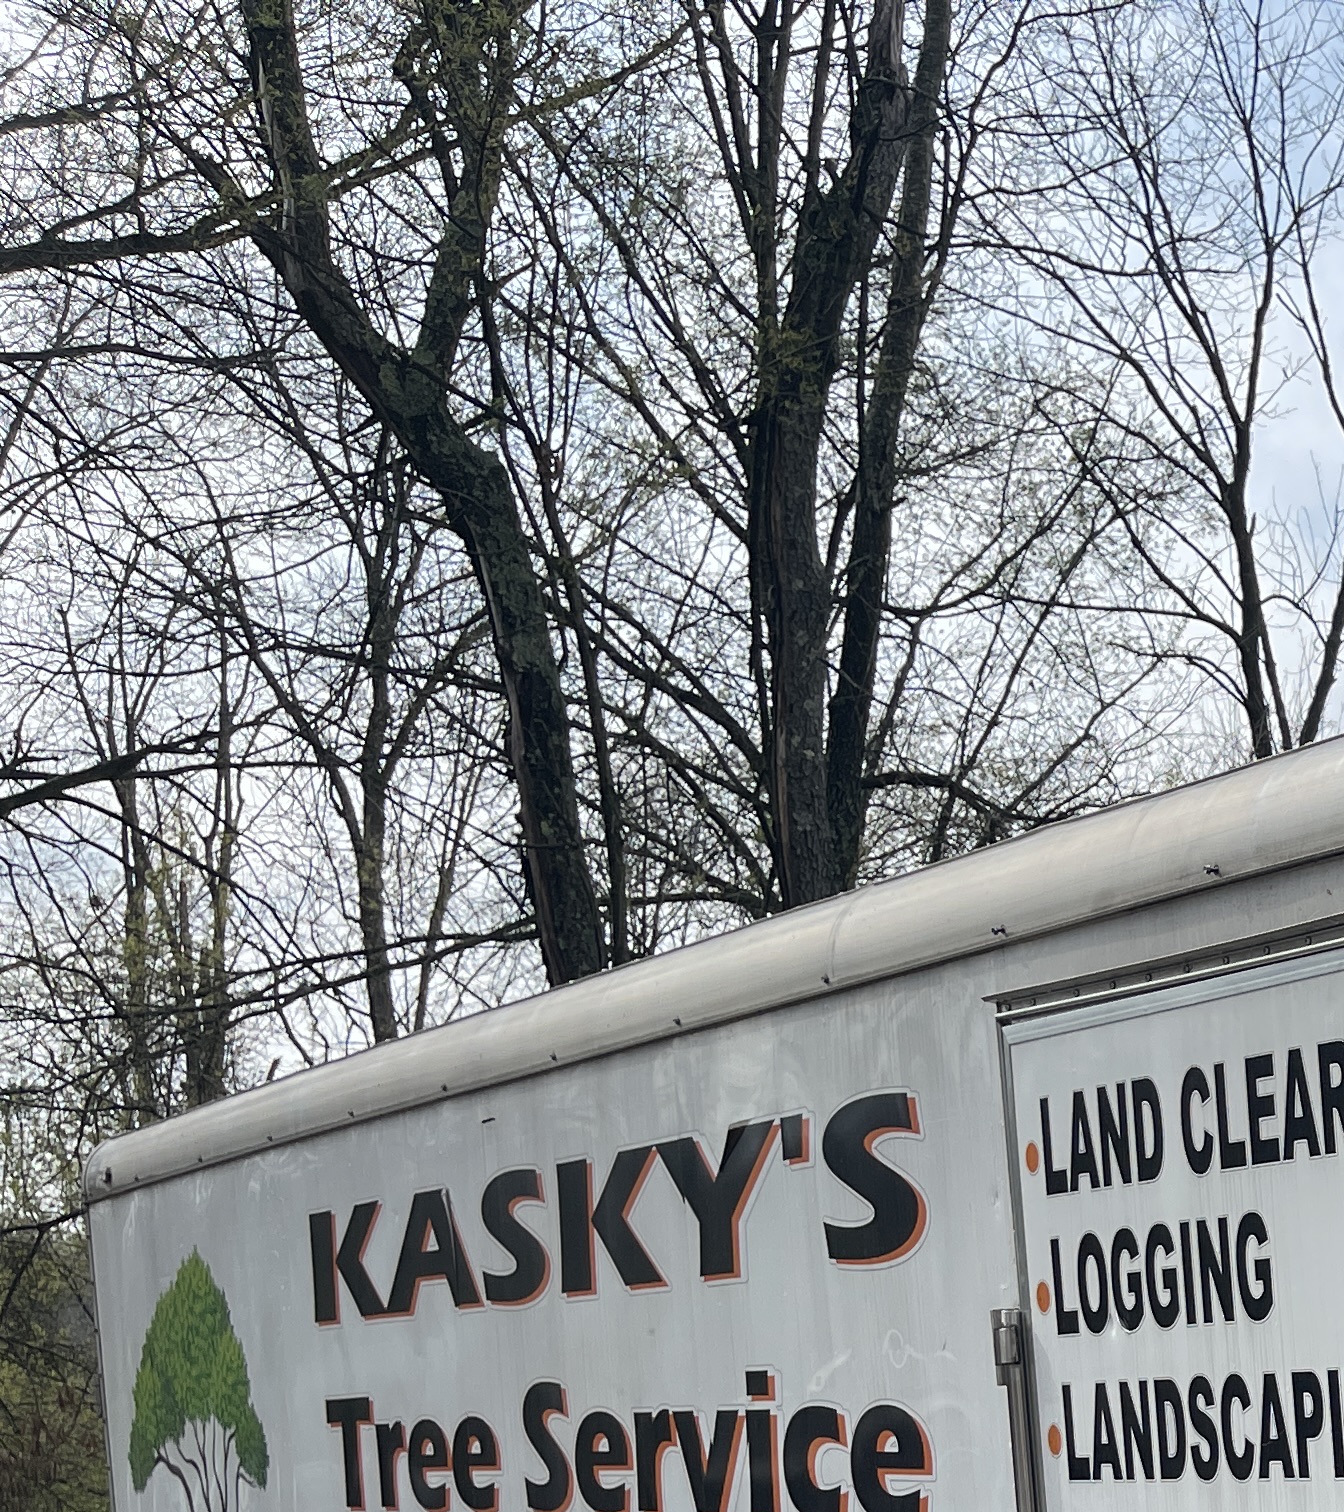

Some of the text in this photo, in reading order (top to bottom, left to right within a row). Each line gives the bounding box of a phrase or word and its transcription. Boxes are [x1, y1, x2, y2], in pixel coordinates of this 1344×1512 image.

[1040, 1078, 1163, 1195] LAND
[309, 1093, 925, 1326] KASKY'S
[1050, 1212, 1273, 1335] LOGGING
[325, 1397, 501, 1512] Tree
